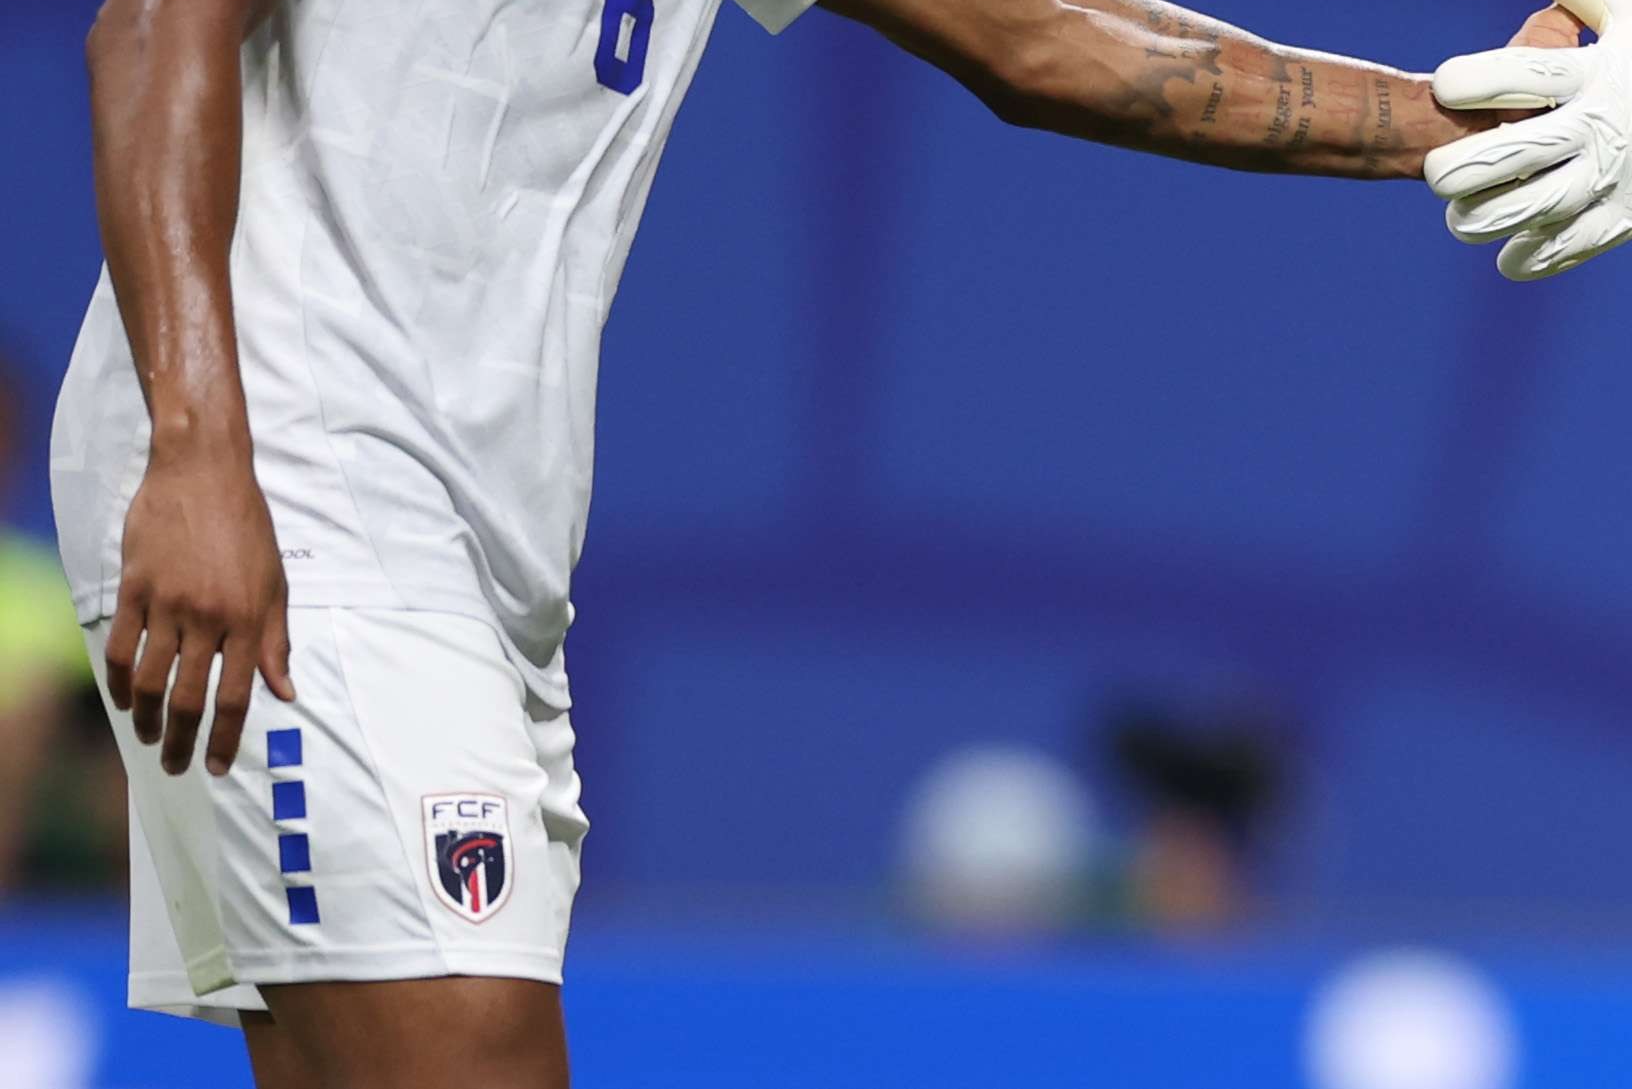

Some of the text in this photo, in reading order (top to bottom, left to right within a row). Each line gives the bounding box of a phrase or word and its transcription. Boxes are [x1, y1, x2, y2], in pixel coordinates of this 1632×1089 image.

[1200, 81, 1223, 123] your
[1301, 66, 1317, 108] your
[1263, 84, 1292, 144] bigger
[432, 800, 501, 820] FCF
